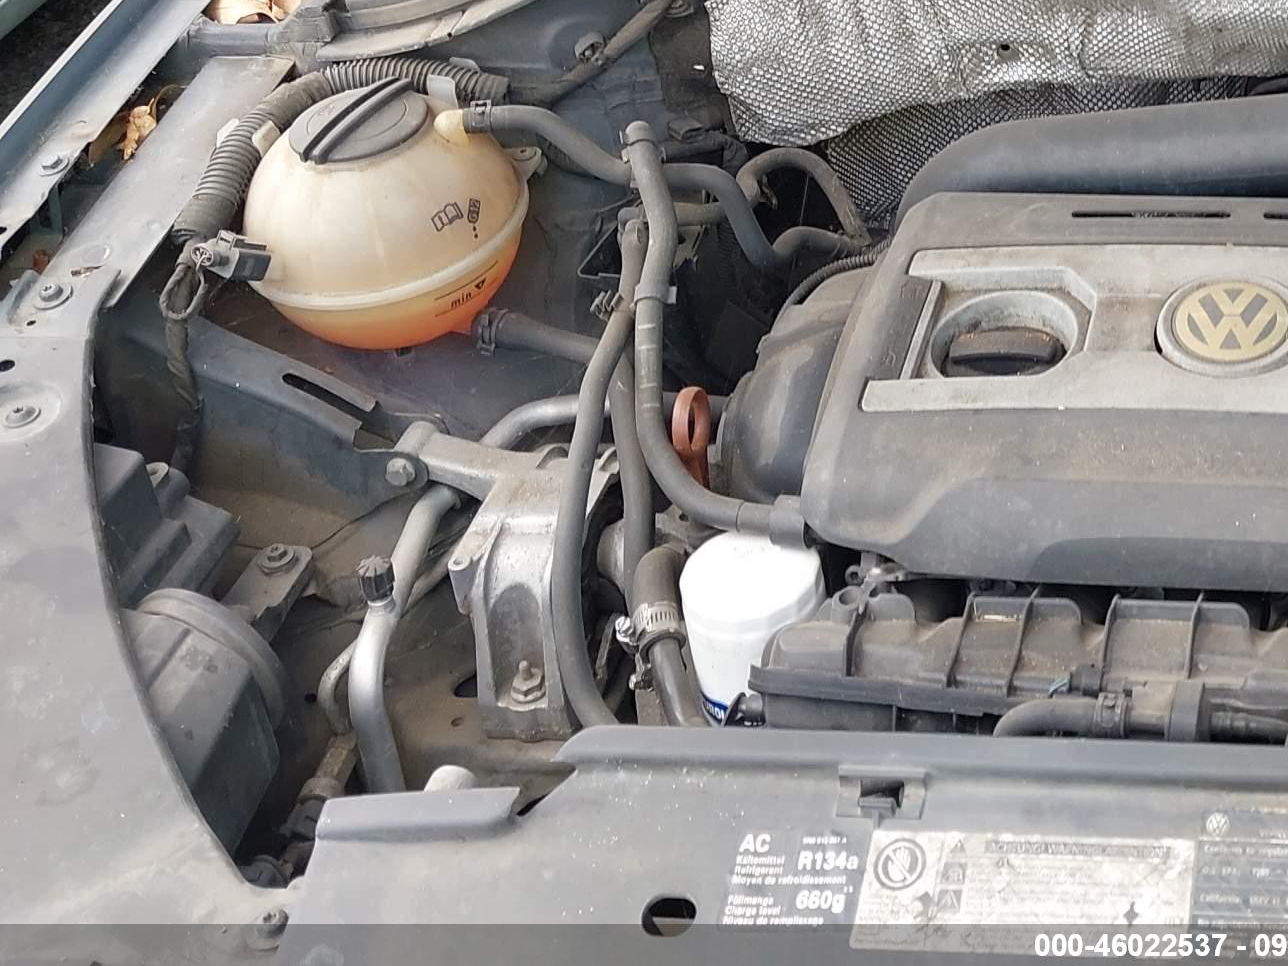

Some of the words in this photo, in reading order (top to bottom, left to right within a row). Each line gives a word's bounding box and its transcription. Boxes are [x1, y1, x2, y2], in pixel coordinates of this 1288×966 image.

[451, 292, 472, 309] min
[739, 833, 771, 853] AC
[991, 841, 1047, 854] ACHUNG!
[797, 850, 859, 870] R134a
[734, 865, 783, 876] Refrigerant
[732, 875, 762, 886] Moyen
[764, 875, 776, 885] de
[778, 875, 846, 885] refroidissement
[796, 889, 846, 914] 660g
[725, 905, 757, 917] Charge
[759, 905, 781, 915] level
[723, 916, 754, 925] Niveau
[756, 916, 768, 925] de
[770, 916, 824, 927] remplissage
